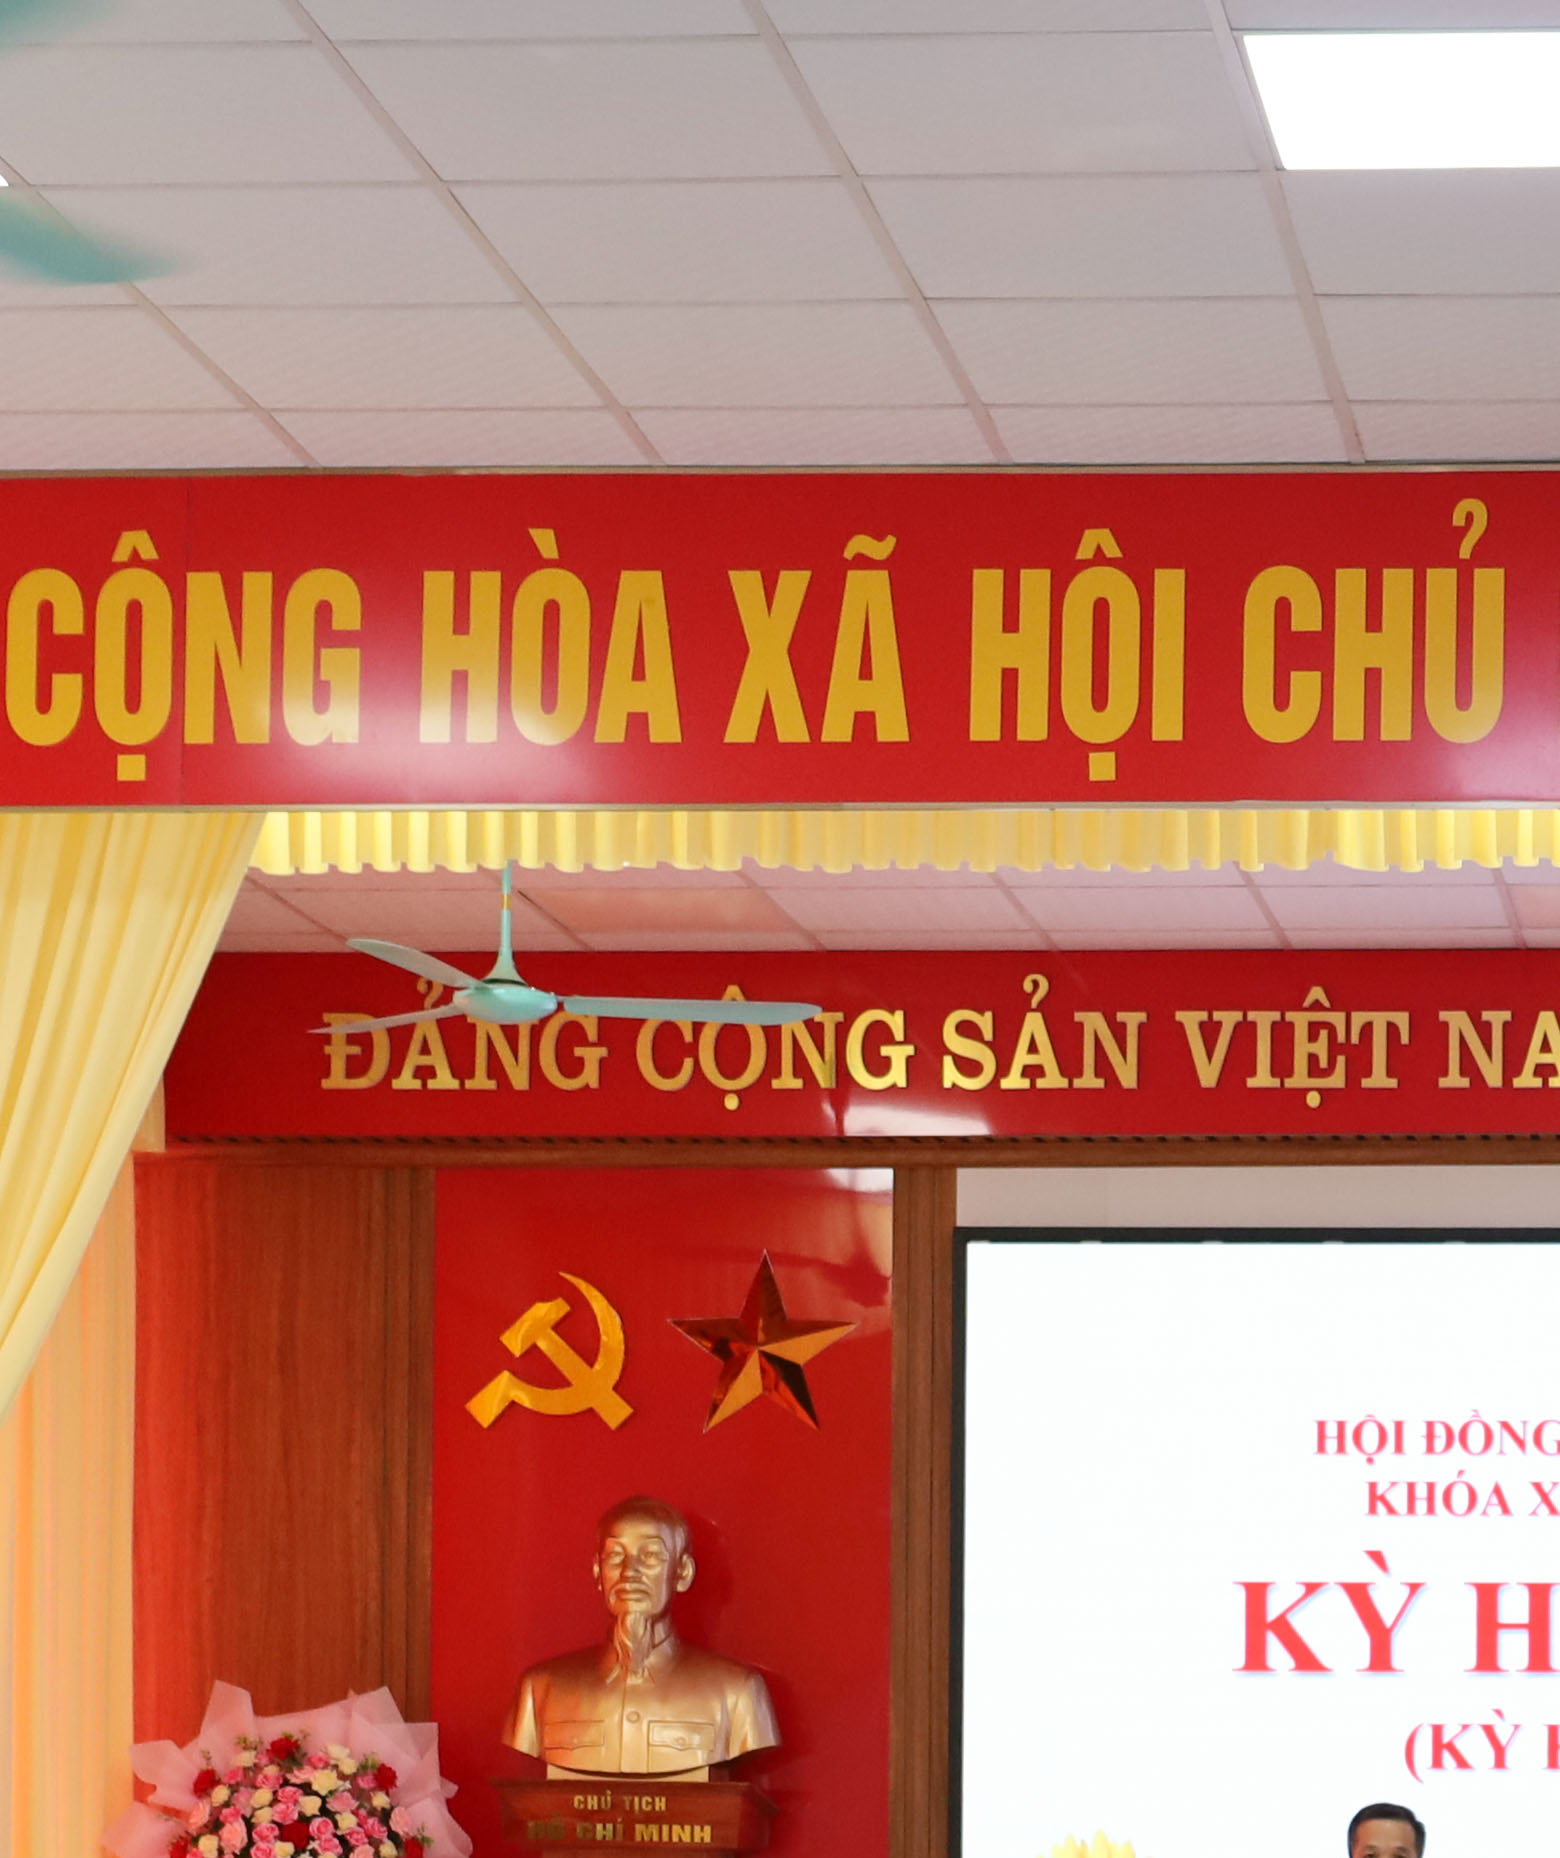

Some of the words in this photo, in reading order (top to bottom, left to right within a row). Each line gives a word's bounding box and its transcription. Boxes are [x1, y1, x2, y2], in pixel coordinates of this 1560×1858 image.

[6, 530, 361, 781] CỘNG
[421, 529, 682, 743] HÒA
[724, 534, 910, 743] XÃ
[970, 529, 1185, 781] HỘI
[1242, 499, 1505, 743] CHỦ
[322, 976, 607, 1090] ĐẢNG
[636, 984, 916, 1111] CỘNG
[940, 973, 1147, 1091] SẢN
[1175, 986, 1409, 1107] VIỆT
[1316, 1414, 1405, 1466] HỘI
[1367, 1469, 1513, 1518] KHÓA
[1234, 1549, 1427, 1674] KỲ
[1404, 1708, 1521, 1782] (KỲ
[573, 1790, 612, 1810] CHỦ
[623, 1796, 666, 1813] TỊCH
[634, 1824, 712, 1843] MINH
